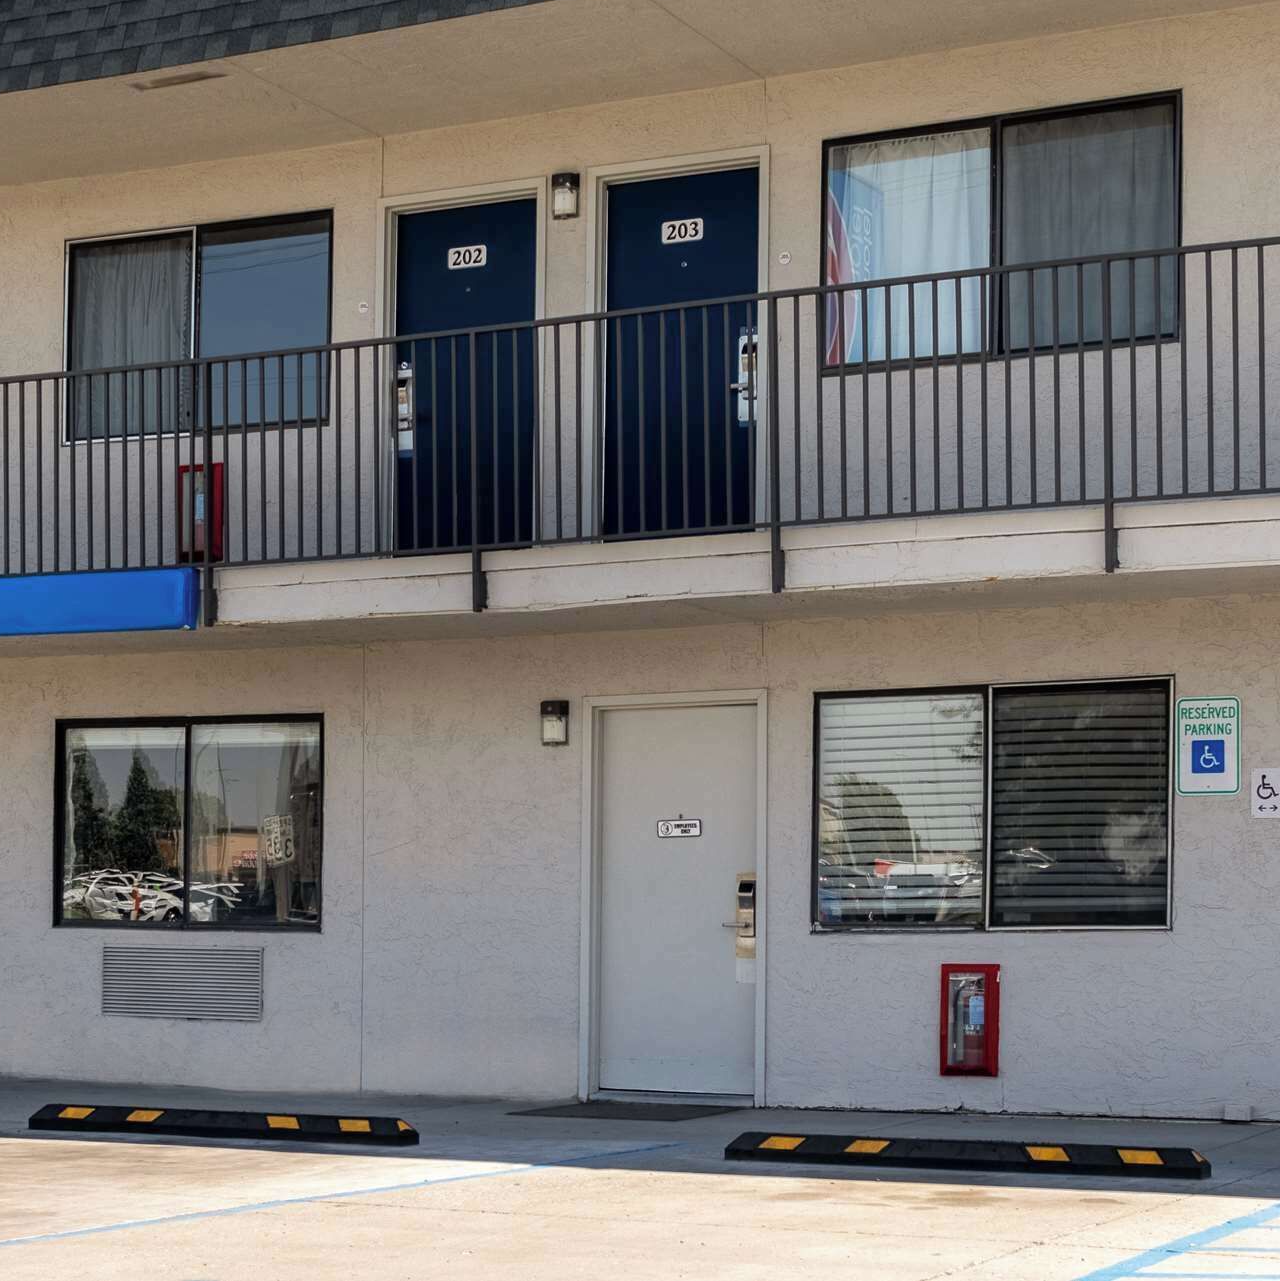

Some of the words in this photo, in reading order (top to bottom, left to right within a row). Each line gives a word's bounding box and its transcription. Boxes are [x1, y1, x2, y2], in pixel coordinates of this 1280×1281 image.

[666, 221, 700, 241] 203
[452, 247, 483, 267] 202
[1181, 706, 1236, 720] RESERVED
[1184, 723, 1232, 736] PARKING
